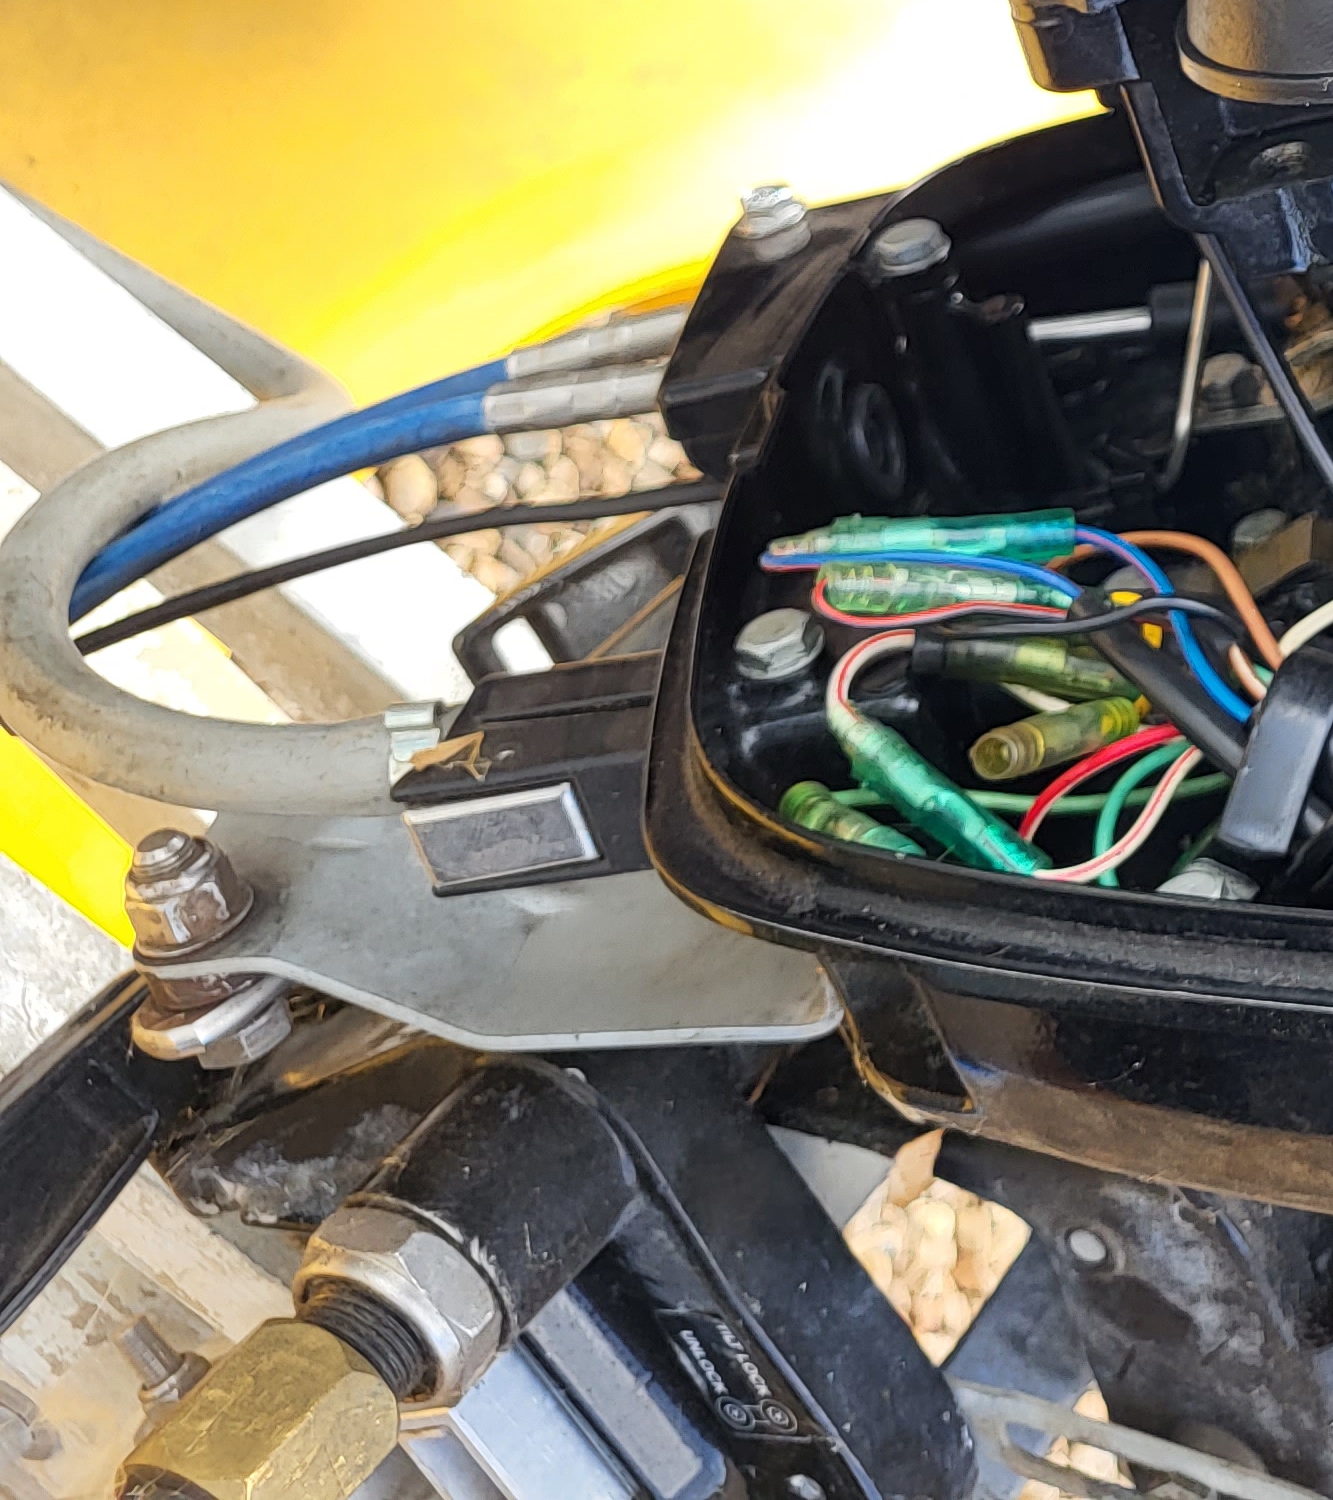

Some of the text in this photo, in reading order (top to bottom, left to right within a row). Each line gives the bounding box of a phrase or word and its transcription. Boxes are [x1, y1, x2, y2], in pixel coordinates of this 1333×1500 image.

[679, 1329, 730, 1396] UNLOCK
[715, 1323, 773, 1398] TILT LOCK
